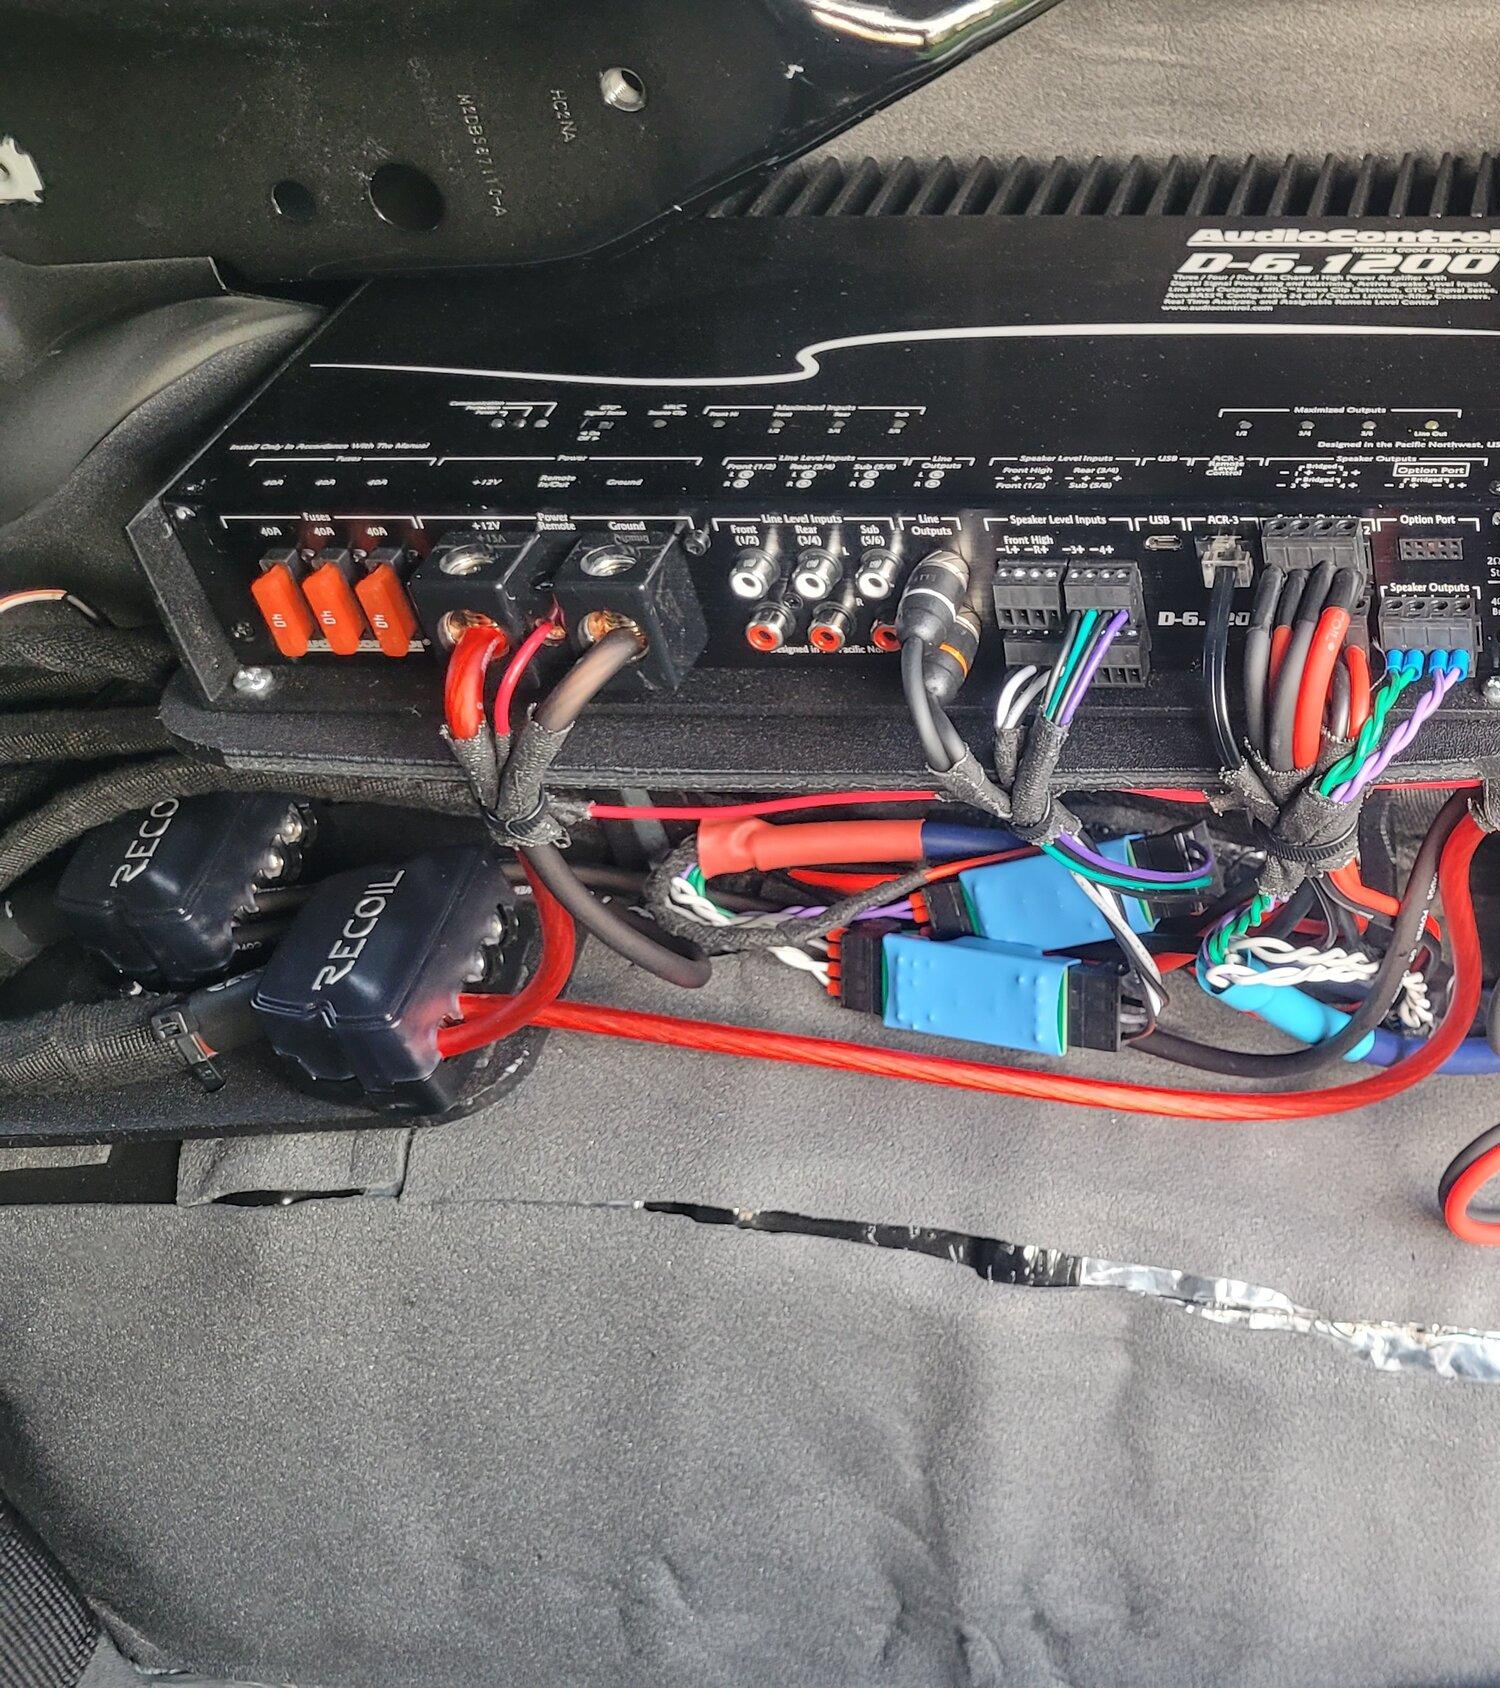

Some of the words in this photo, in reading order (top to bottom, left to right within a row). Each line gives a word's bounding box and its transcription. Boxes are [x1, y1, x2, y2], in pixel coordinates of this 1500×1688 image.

[1177, 252, 1500, 274] D-6.1200
[1318, 441, 1361, 449] Designed
[1364, 441, 1373, 449] in
[1376, 441, 1393, 449] the
[1395, 441, 1426, 449] Pacific
[1428, 441, 1484, 449] Northwest,
[1019, 455, 1056, 463] Speaker
[1058, 455, 1082, 463] Level
[1083, 455, 1113, 463] Inputs
[1336, 455, 1373, 463] Speaker
[1376, 455, 1417, 463] Outputs
[1398, 466, 1438, 475] Option
[1441, 466, 1465, 475] Port
[303, 512, 331, 522] Fuses
[761, 514, 782, 524] Line
[783, 514, 809, 524] Level
[811, 514, 842, 524] Inputs
[918, 514, 939, 523] Line
[1010, 515, 1046, 525] Speaker
[1049, 515, 1074, 525] Level
[1076, 515, 1107, 525] Inputs
[1149, 515, 1170, 524] USB
[1208, 516, 1239, 524] ACR-3
[1401, 515, 1433, 525] Option
[1436, 515, 1456, 525] Port
[472, 522, 500, 531] +12V
[537, 522, 576, 531] Remote
[608, 522, 646, 531] Ground
[730, 525, 758, 534] Front
[795, 525, 818, 534] Rear
[860, 525, 879, 534] Sub
[260, 527, 282, 536] 40A
[314, 527, 335, 536] 40A
[367, 527, 388, 536] 40A
[912, 526, 952, 537] Outputs
[735, 535, 760, 546] (1/2)
[1004, 535, 1029, 545] Front
[1031, 535, 1054, 545] High
[1390, 583, 1426, 593] Speaker
[1429, 583, 1470, 593] Outputs
[312, 868, 406, 993] RECOIL
